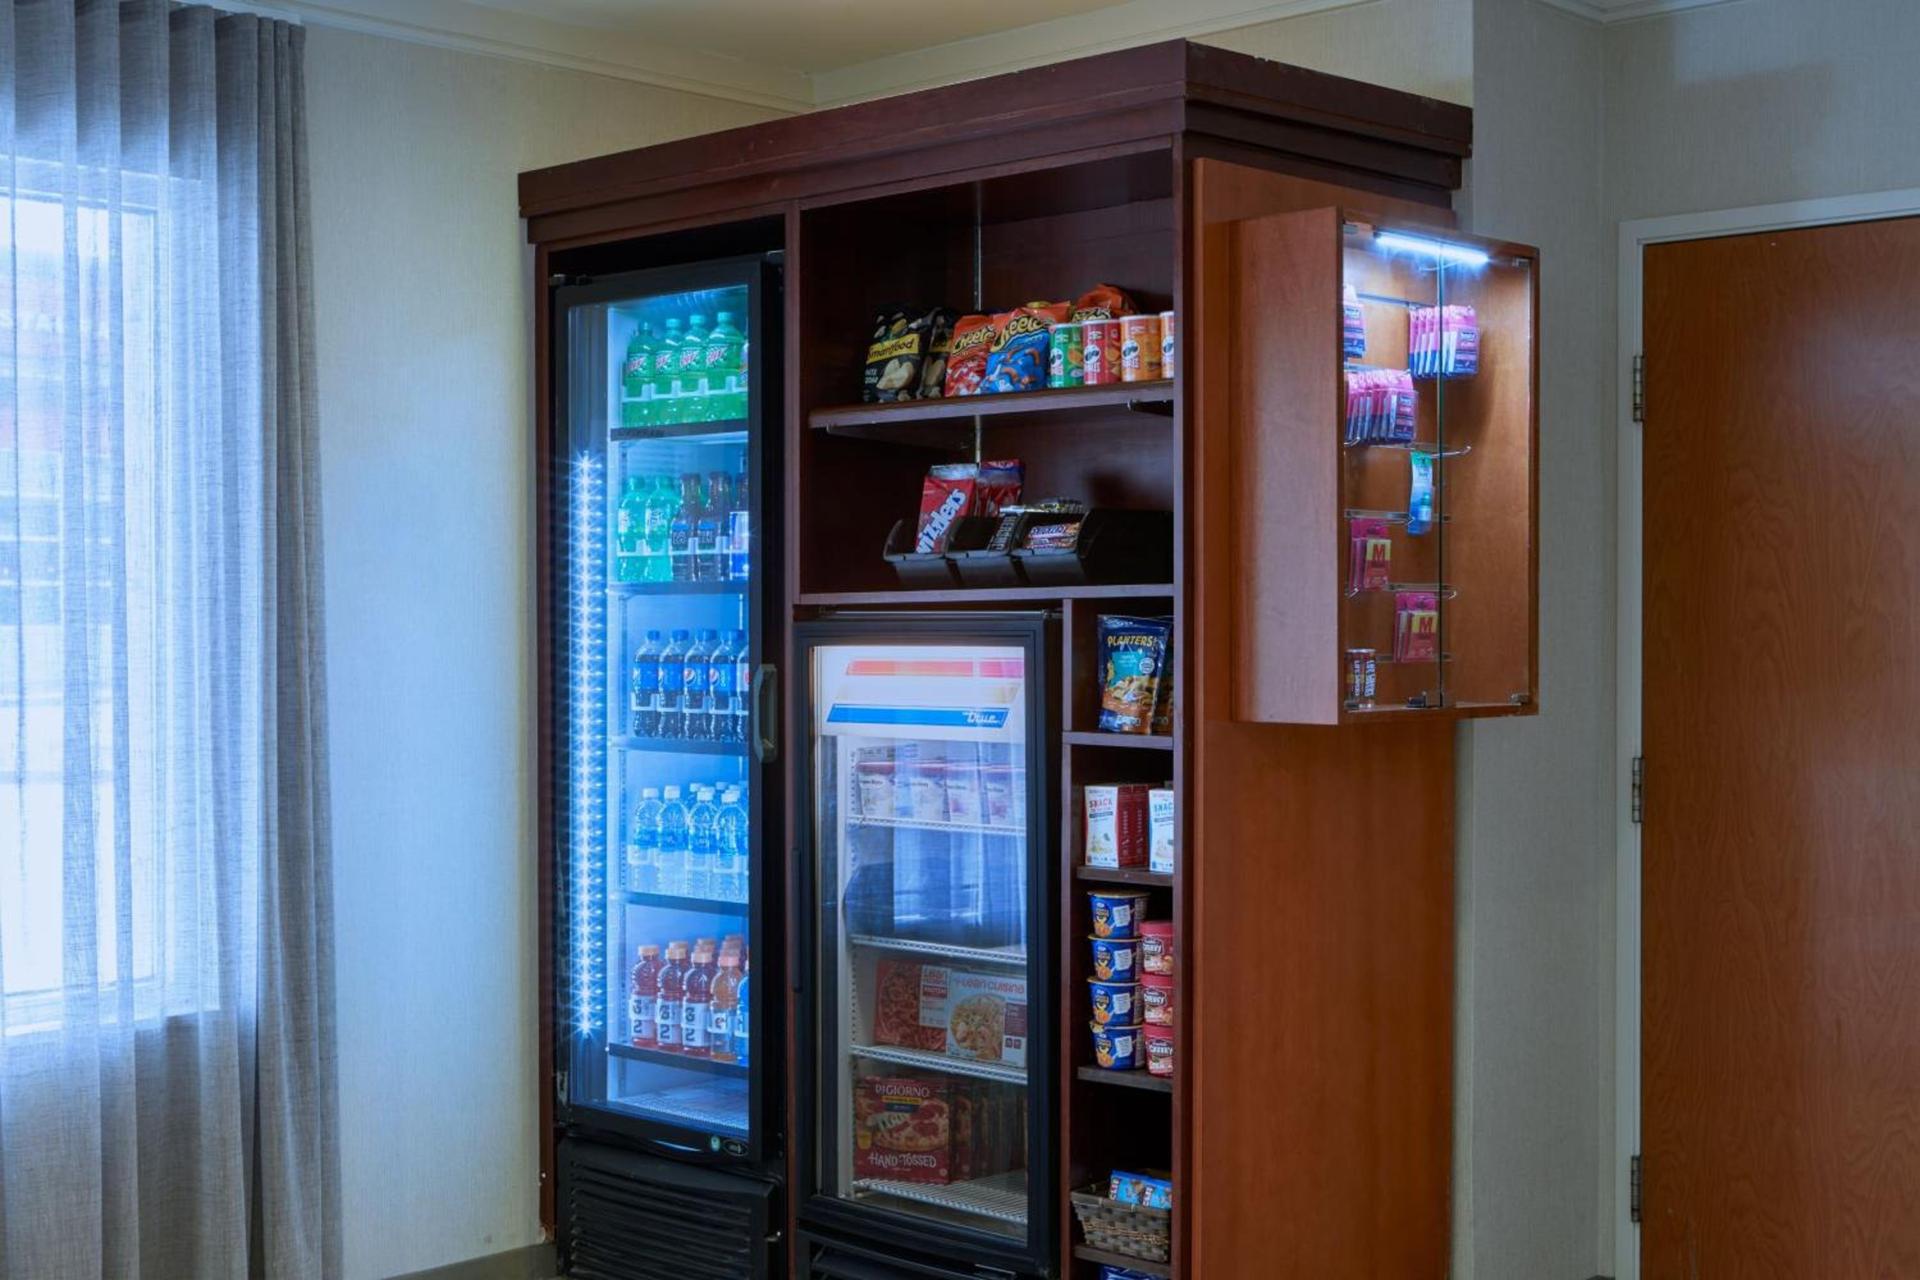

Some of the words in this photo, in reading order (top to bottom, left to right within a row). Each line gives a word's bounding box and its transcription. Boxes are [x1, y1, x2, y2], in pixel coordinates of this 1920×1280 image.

[914, 487, 967, 554] wizzlers
[1107, 635, 1153, 648] PLANTERS
[1154, 803, 1173, 812] SNAC
